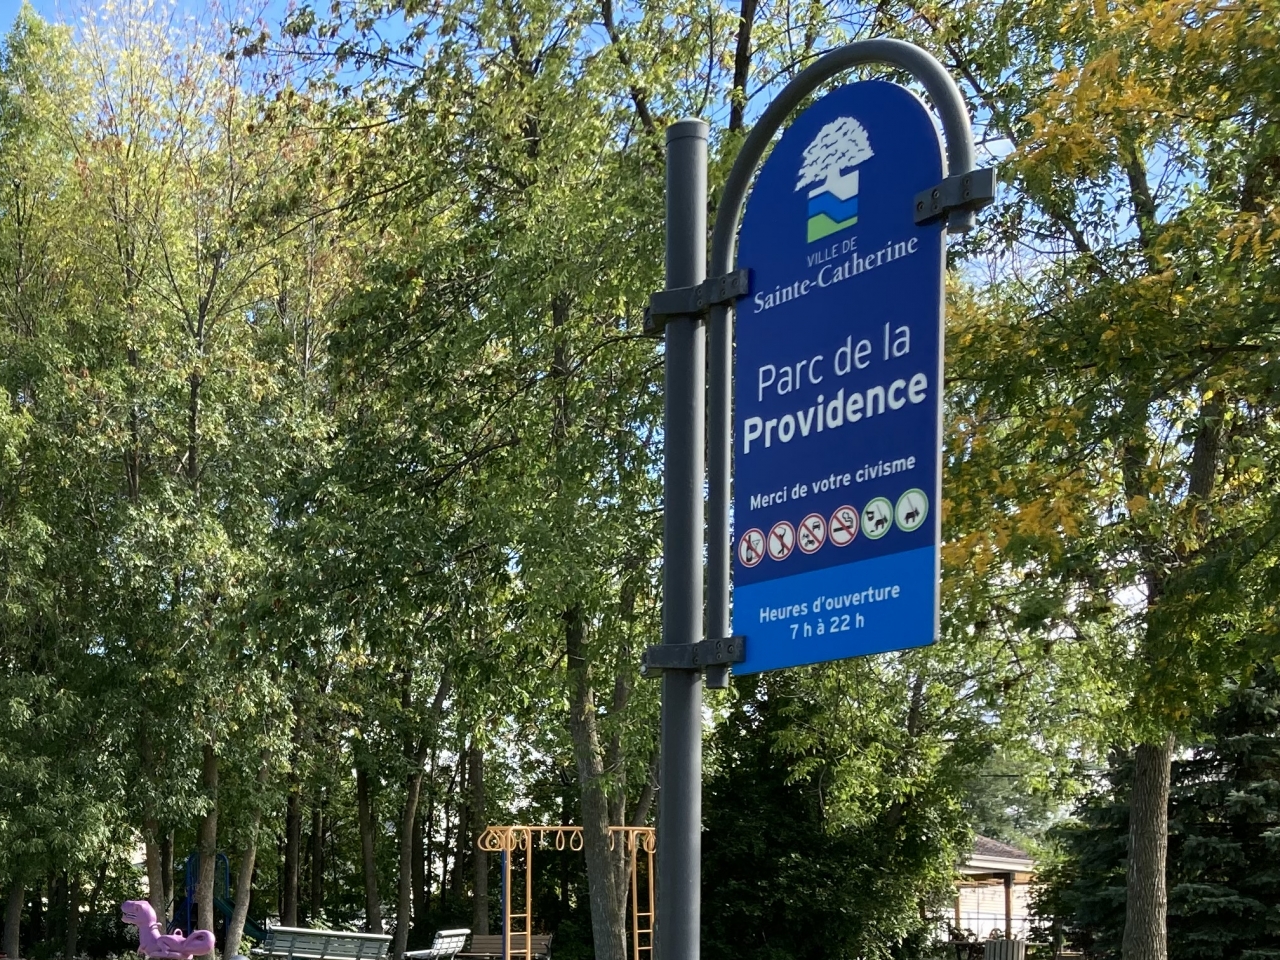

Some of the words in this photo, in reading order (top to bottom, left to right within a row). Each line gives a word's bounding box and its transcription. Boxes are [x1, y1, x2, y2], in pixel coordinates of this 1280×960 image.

[753, 236, 919, 314] Sainte-Catherine
[807, 243, 839, 267] VILLE
[842, 236, 858, 254] DE
[758, 354, 824, 402] Parc
[834, 335, 872, 376] de
[883, 321, 911, 361] la
[743, 372, 928, 455] Providence
[750, 484, 787, 511] Merci
[791, 482, 808, 500] de
[812, 472, 851, 494] votre
[855, 455, 916, 483] civisme
[759, 602, 808, 623] Heures
[812, 584, 901, 613] d'ouverture
[789, 624, 799, 640] 7
[803, 621, 812, 638] h
[816, 618, 825, 635] à
[830, 614, 850, 633] 22
[855, 612, 865, 628] h
